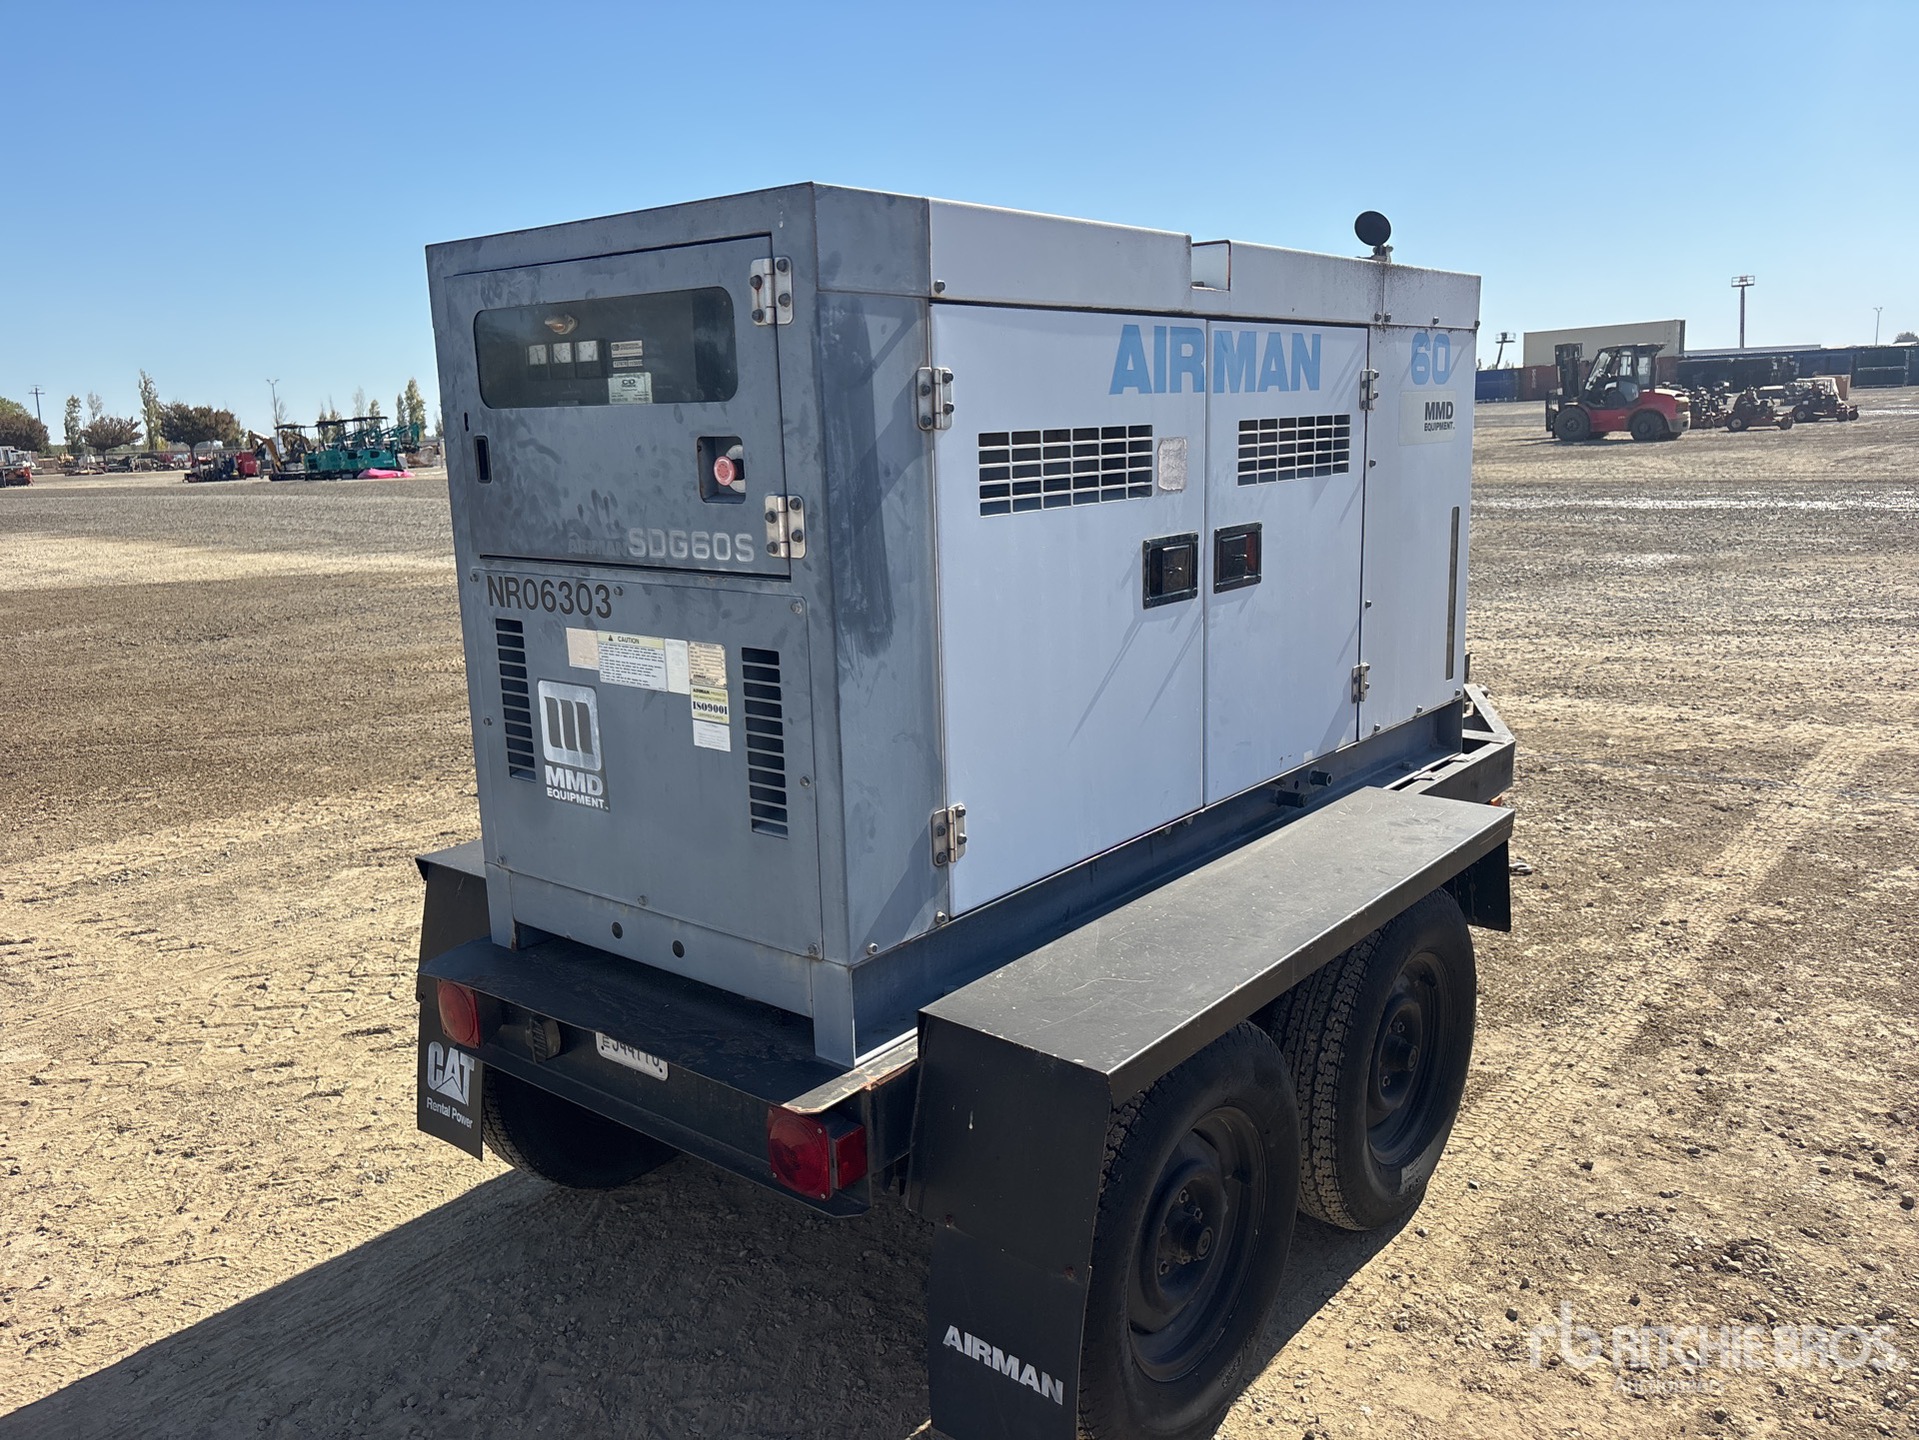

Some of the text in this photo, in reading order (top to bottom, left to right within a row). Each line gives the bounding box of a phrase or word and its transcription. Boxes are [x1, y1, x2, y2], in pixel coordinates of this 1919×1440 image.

[1109, 324, 1321, 395] AIRMAN
[1410, 332, 1450, 385] 60
[1424, 401, 1454, 421] MMD
[629, 527, 755, 562] SDG60S
[486, 575, 612, 618] NR06303
[617, 635, 640, 645] CAUTION
[692, 700, 728, 715] ISO9001
[544, 764, 603, 796] MMD
[427, 1041, 475, 1107] CAT
[426, 1096, 473, 1129] Rental Power
[942, 1324, 1064, 1406] AIRMAN
